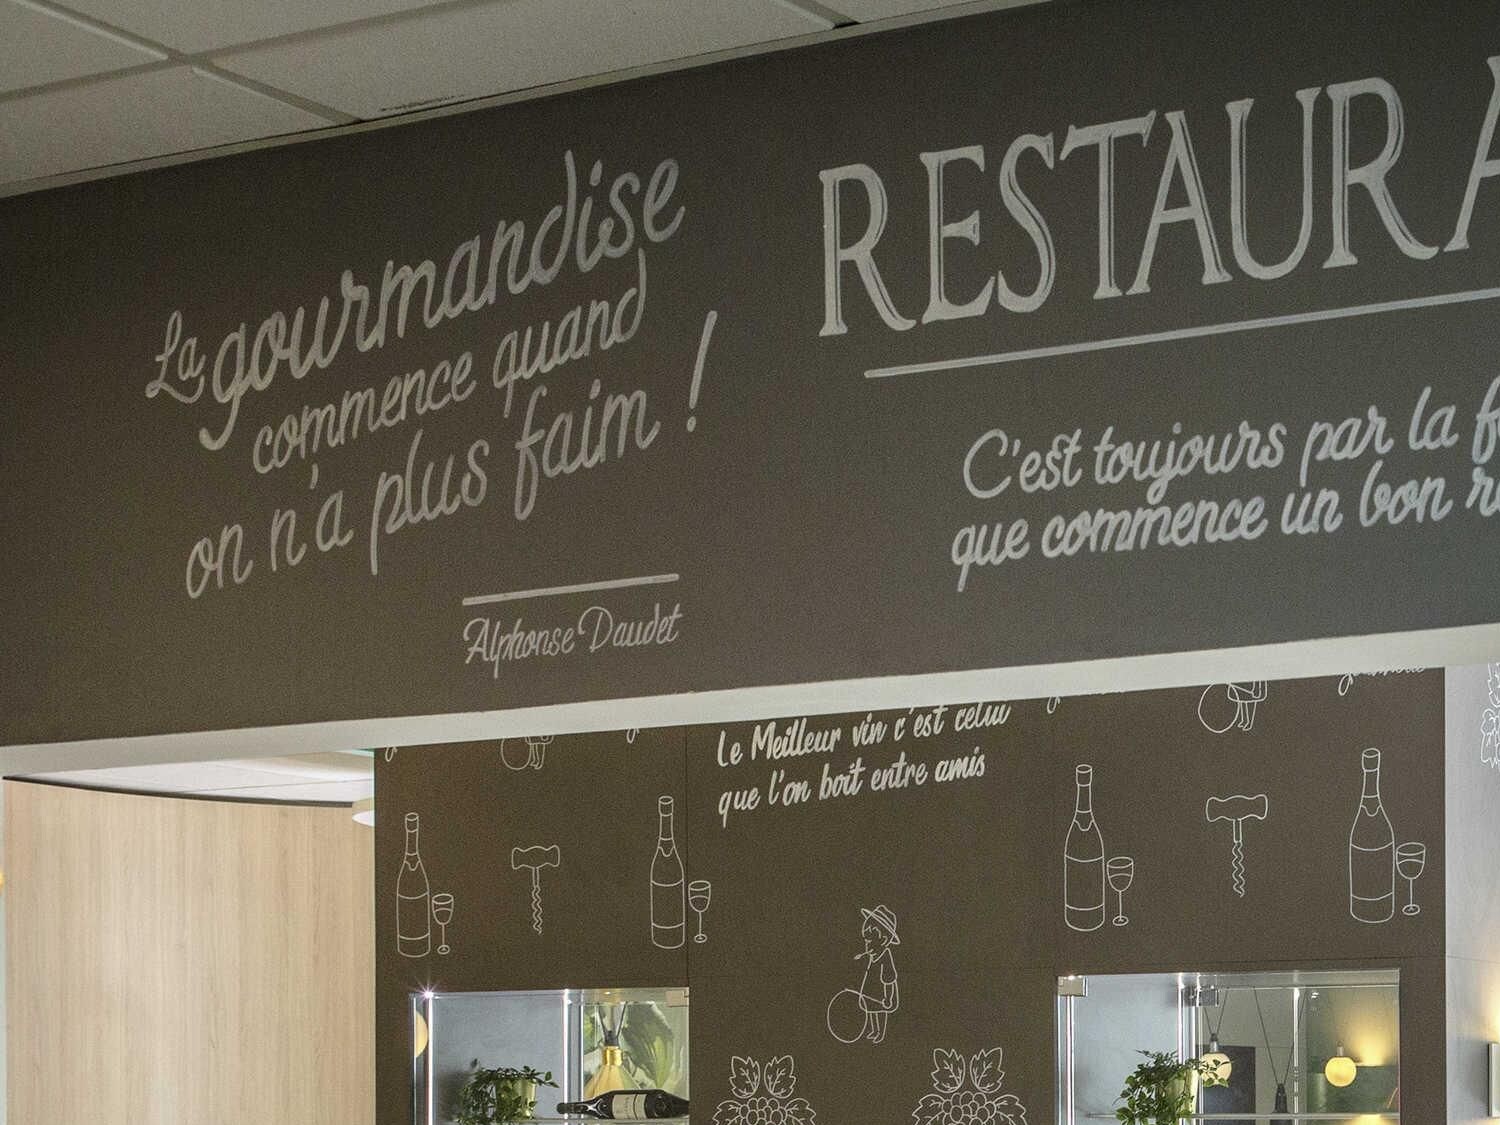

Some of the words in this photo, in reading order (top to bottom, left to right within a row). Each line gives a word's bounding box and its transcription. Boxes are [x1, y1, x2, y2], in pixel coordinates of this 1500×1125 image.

[145, 310, 205, 403] La
[200, 149, 685, 450] gourmandise
[254, 351, 477, 475] commence
[492, 247, 646, 418] quand
[186, 524, 252, 599] on
[271, 463, 353, 571] n'a
[369, 429, 490, 575] plus
[514, 379, 661, 520] faim
[963, 428, 1083, 499] C'est
[1094, 420, 1288, 505] toujours
[1301, 406, 1395, 487] par
[1409, 386, 1459, 450] la
[952, 517, 1030, 593] que
[1041, 495, 1269, 557] commence
[1279, 487, 1344, 537] un
[1360, 460, 1453, 528] bon
[463, 618, 575, 679] Alphonse
[578, 603, 683, 653] Daudet
[717, 730, 743, 767] Le
[752, 718, 841, 760] Meilleur
[853, 712, 887, 747] vin
[895, 705, 948, 740] c'est
[718, 787, 760, 828] que
[769, 770, 811, 806] l'on
[819, 757, 865, 800] boit
[871, 751, 928, 792] entre
[935, 746, 985, 782] amis
